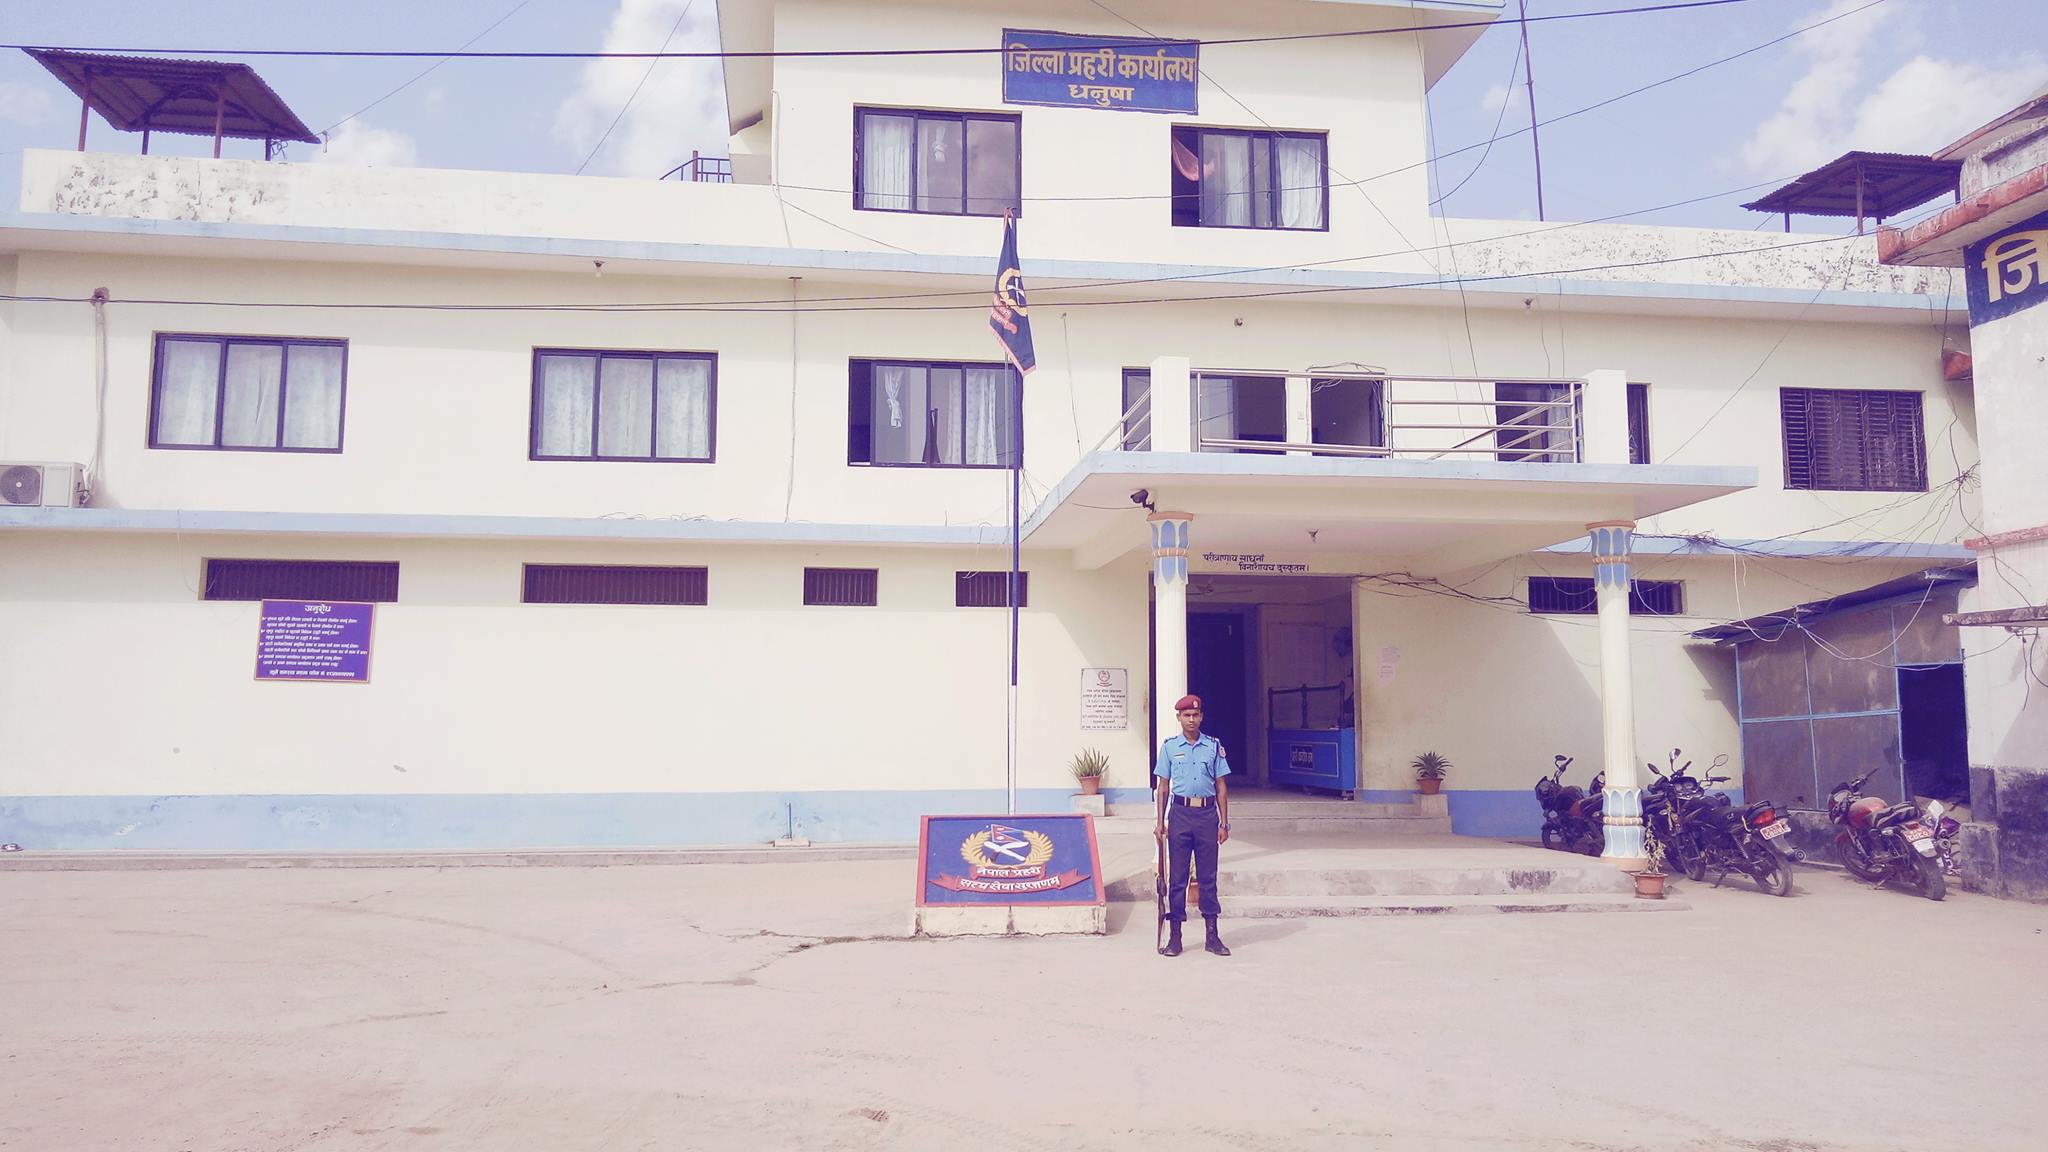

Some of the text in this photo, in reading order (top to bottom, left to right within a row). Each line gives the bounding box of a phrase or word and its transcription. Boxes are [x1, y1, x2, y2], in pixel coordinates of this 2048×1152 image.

[1007, 43, 1196, 82] जिल्ला प्रहरी कार्यालय
[1068, 84, 1135, 106] धनुषा
[304, 604, 332, 614] अनुरोध
